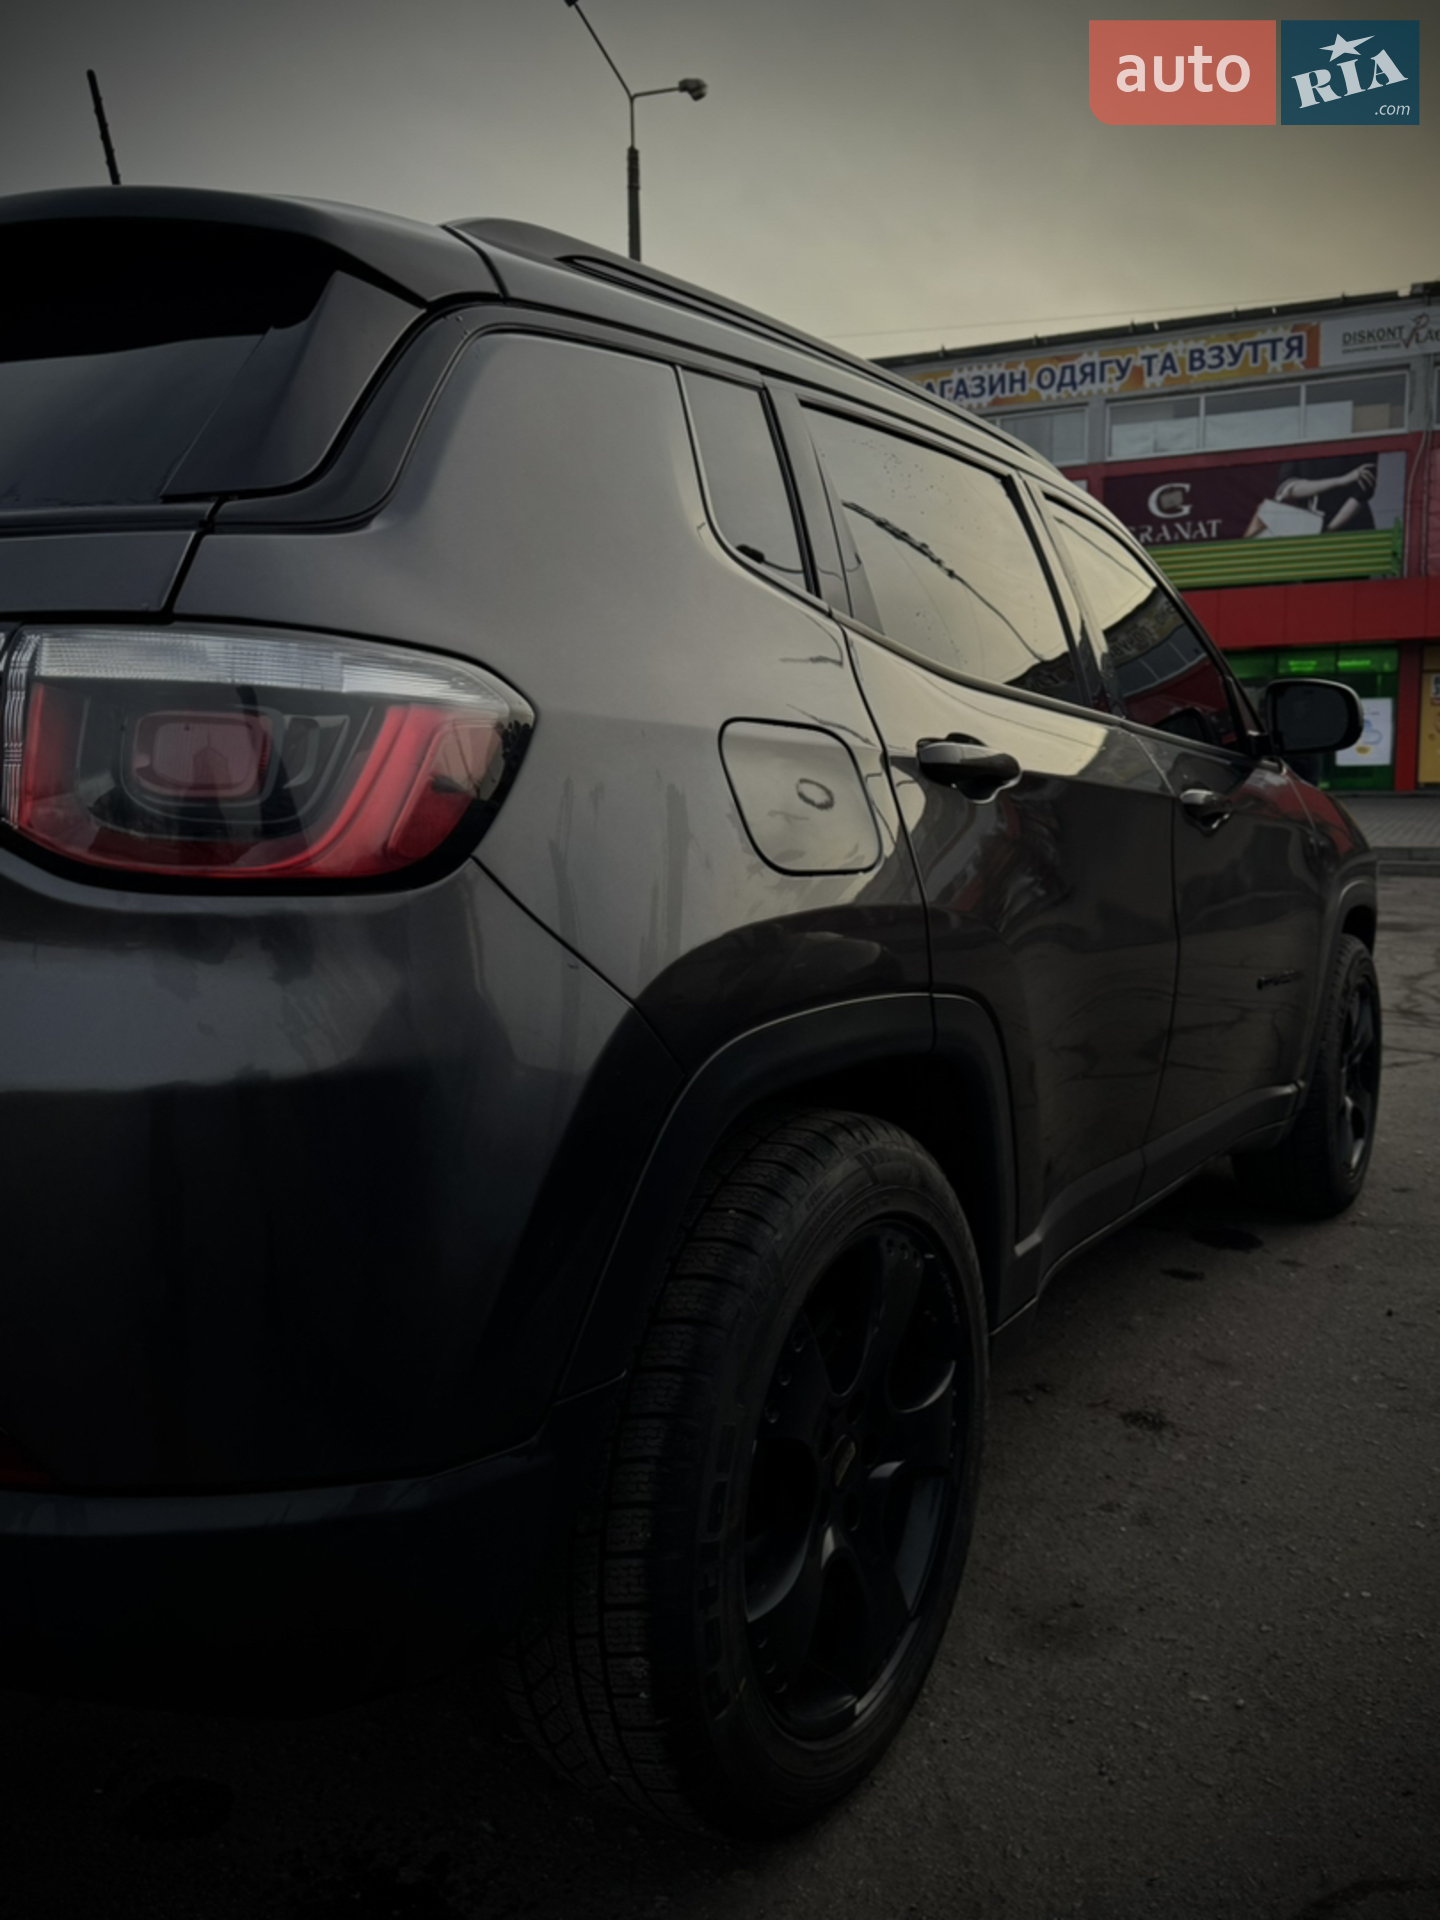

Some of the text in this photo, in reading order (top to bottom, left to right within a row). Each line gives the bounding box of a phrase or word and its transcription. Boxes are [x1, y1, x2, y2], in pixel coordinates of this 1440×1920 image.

[1342, 325, 1404, 345] DISKONT
[1037, 357, 1133, 393] ОДЯГУ
[1142, 352, 1179, 378] ТА
[1188, 334, 1304, 372] ВЗУТТЯ
[1129, 518, 1223, 543] RANAT
